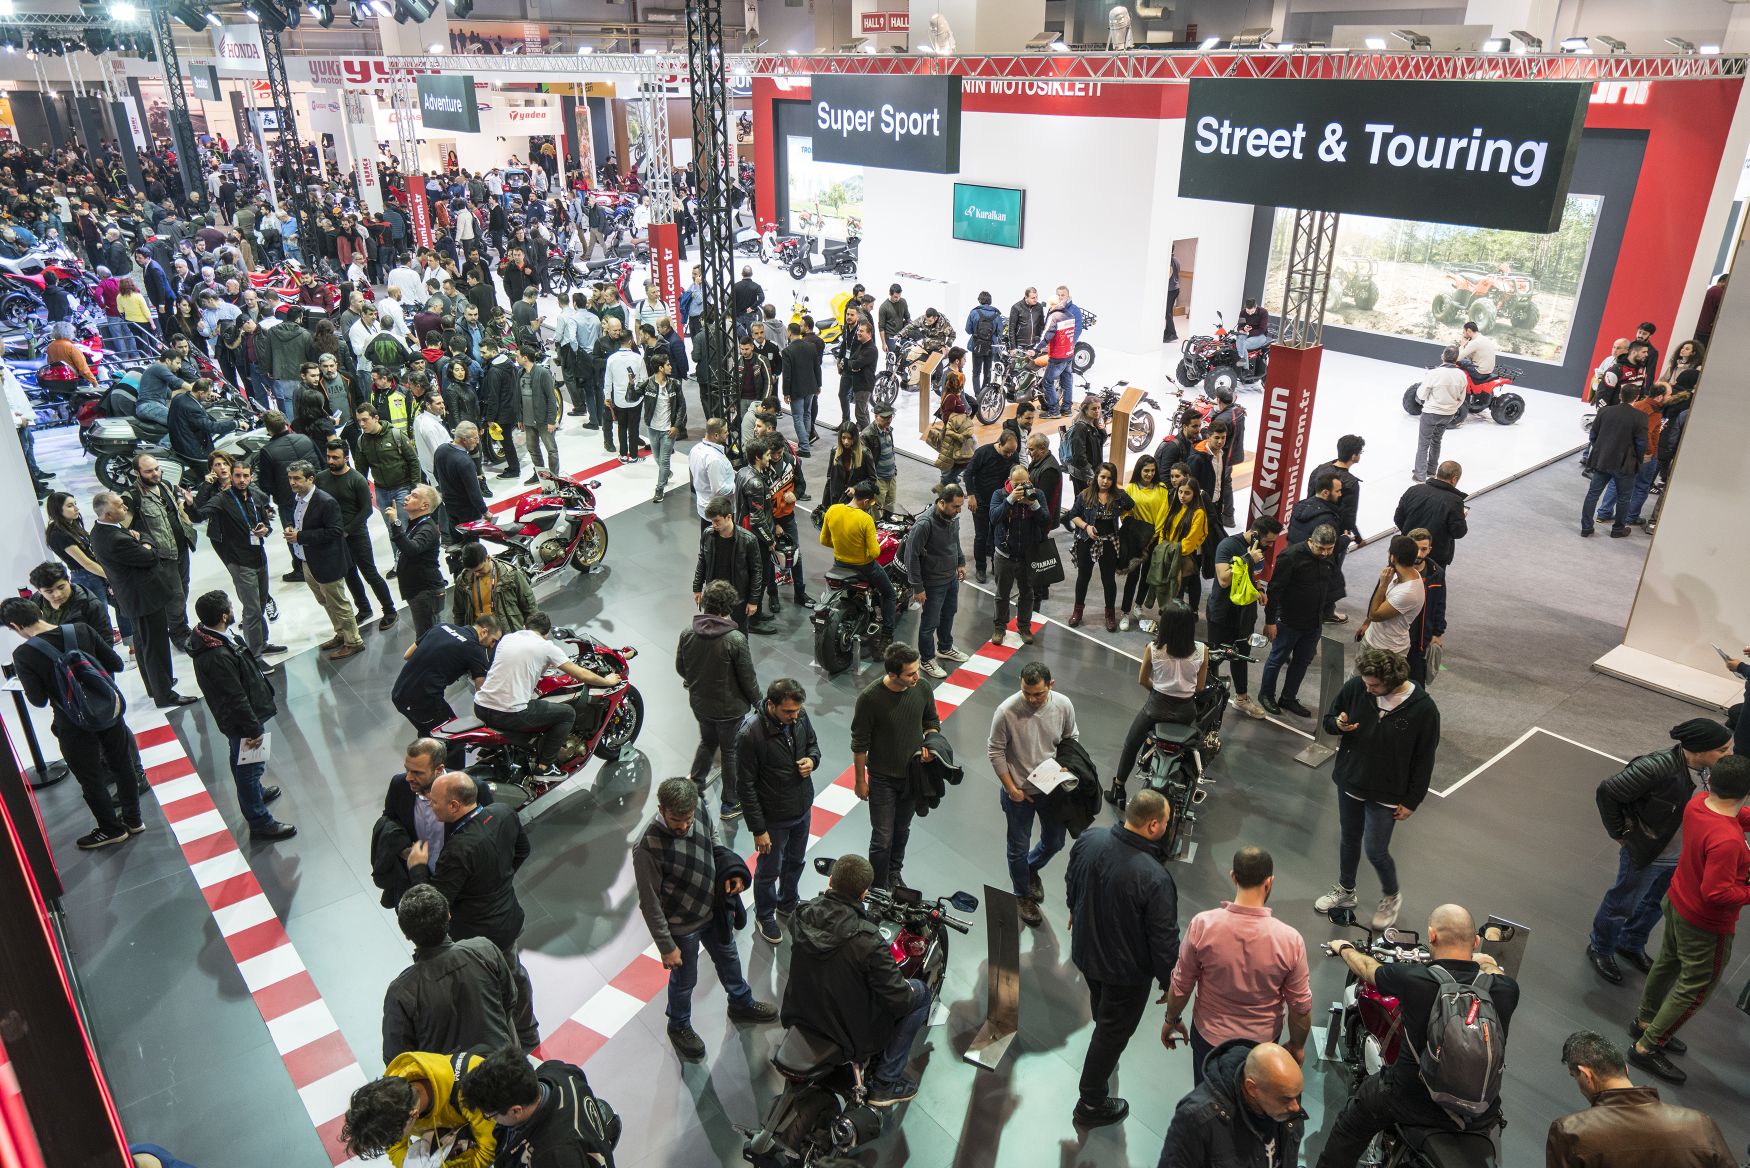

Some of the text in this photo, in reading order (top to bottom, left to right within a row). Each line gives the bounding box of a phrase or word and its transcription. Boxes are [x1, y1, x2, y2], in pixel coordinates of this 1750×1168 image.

[864, 18, 884, 28] HALL 9
[890, 17, 909, 28] HALL
[228, 43, 261, 59] HONDA
[424, 93, 462, 112] Adventure
[817, 102, 940, 141] Super Sport
[1194, 116, 1548, 187] Street & Touring
[975, 209, 1007, 222] Kuralkan
[1279, 389, 1311, 537] kanuni.com.tr
[1036, 557, 1057, 569] YAMAHA
